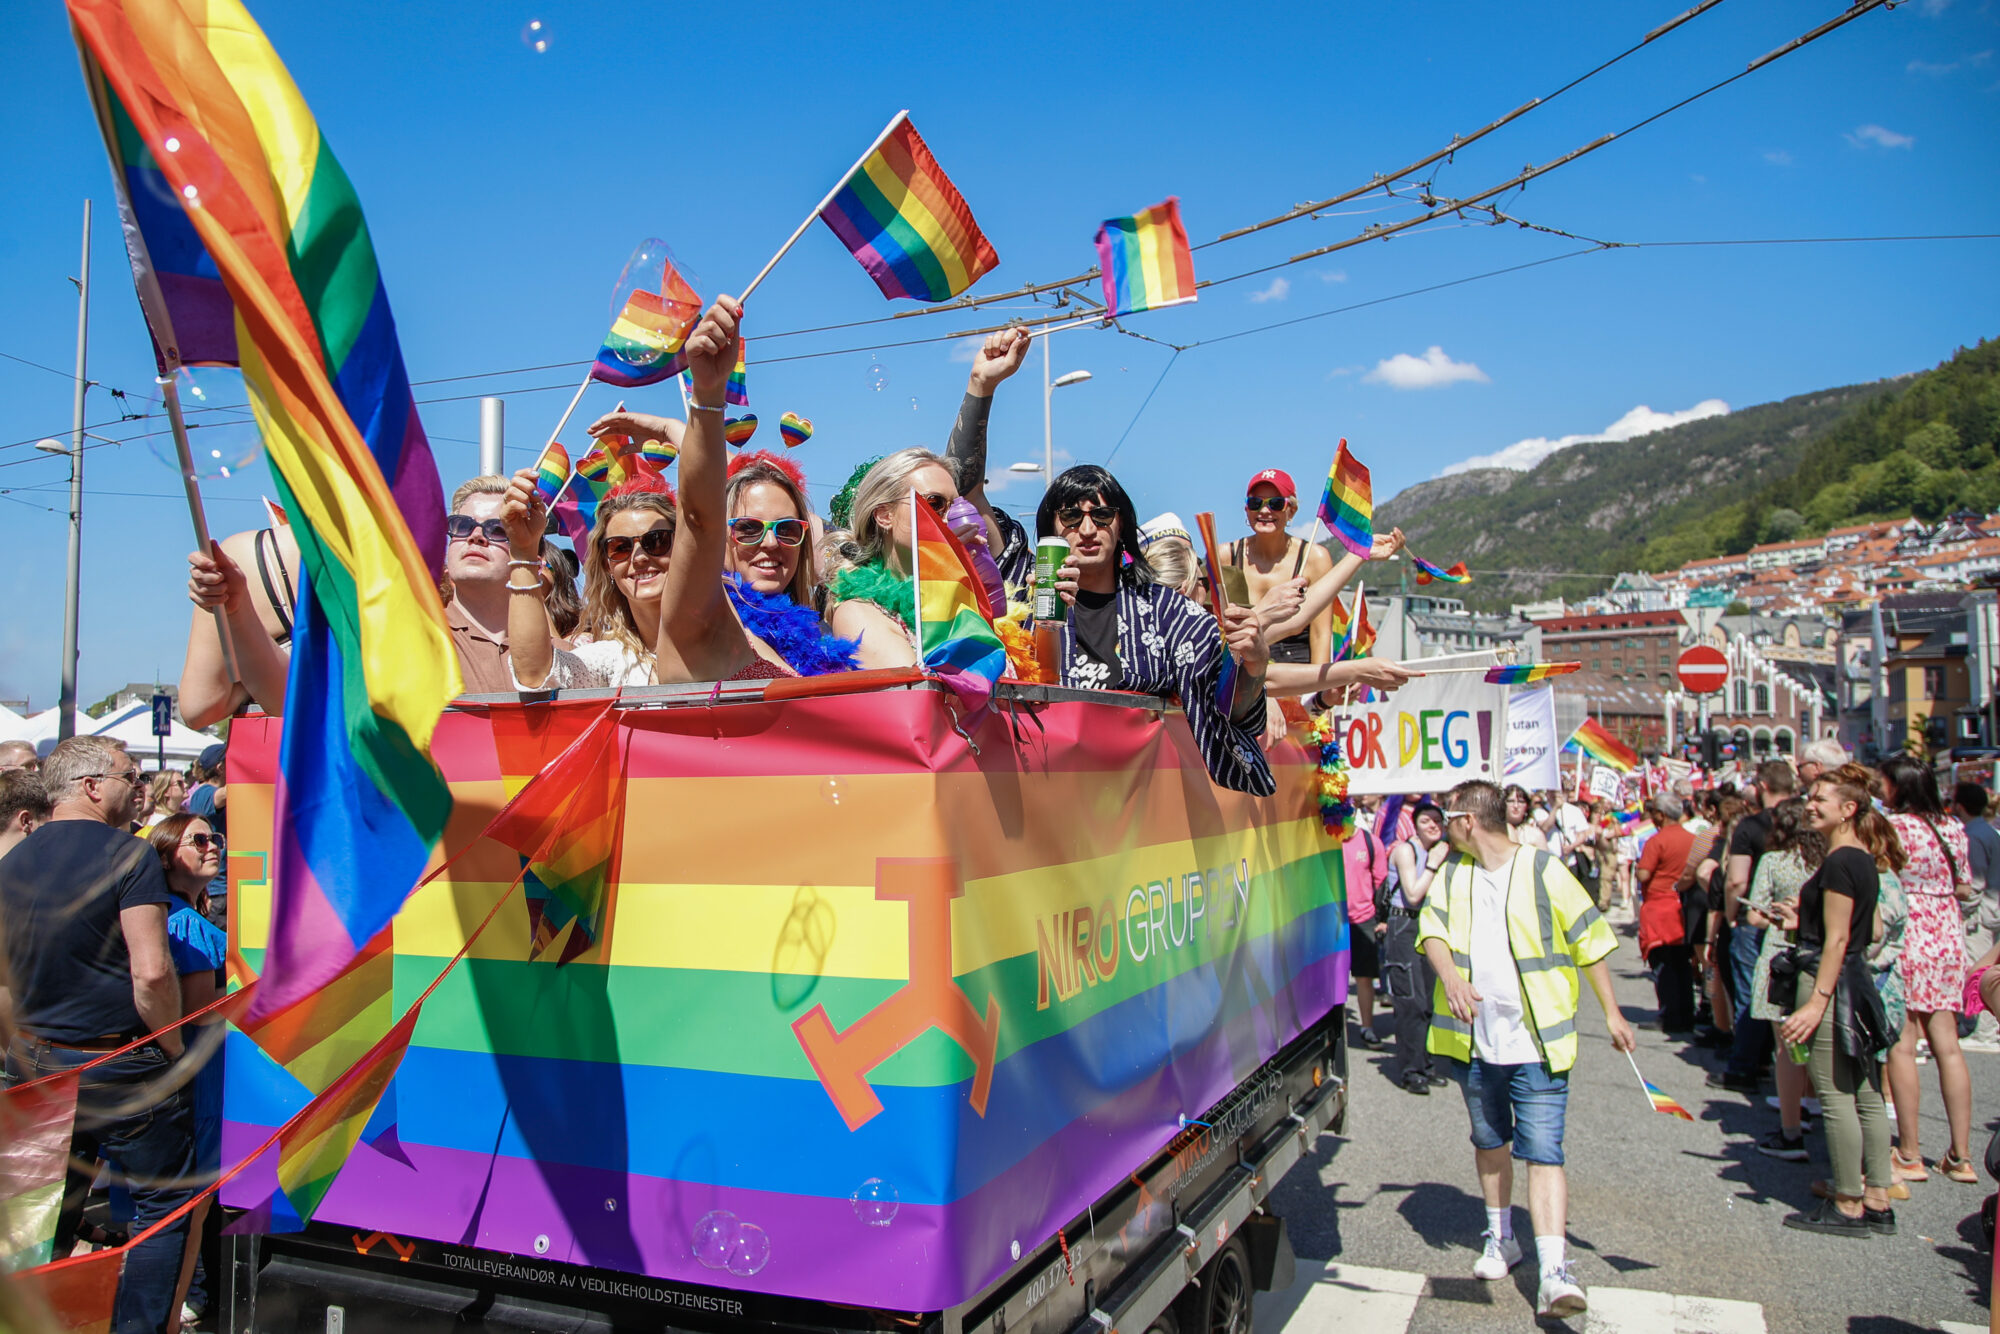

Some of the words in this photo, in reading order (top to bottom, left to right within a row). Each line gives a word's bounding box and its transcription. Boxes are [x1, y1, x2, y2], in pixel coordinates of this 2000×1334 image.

[1034, 898, 1121, 1011] NIRO
[1125, 858, 1249, 966] GRUPPEN
[442, 1253, 556, 1285] TOTALLEVERANDØR
[560, 1274, 576, 1288] AV
[580, 1276, 744, 1316] VEDLIKEHOLDSTJENESTER
[1025, 1275, 1046, 1308] 400
